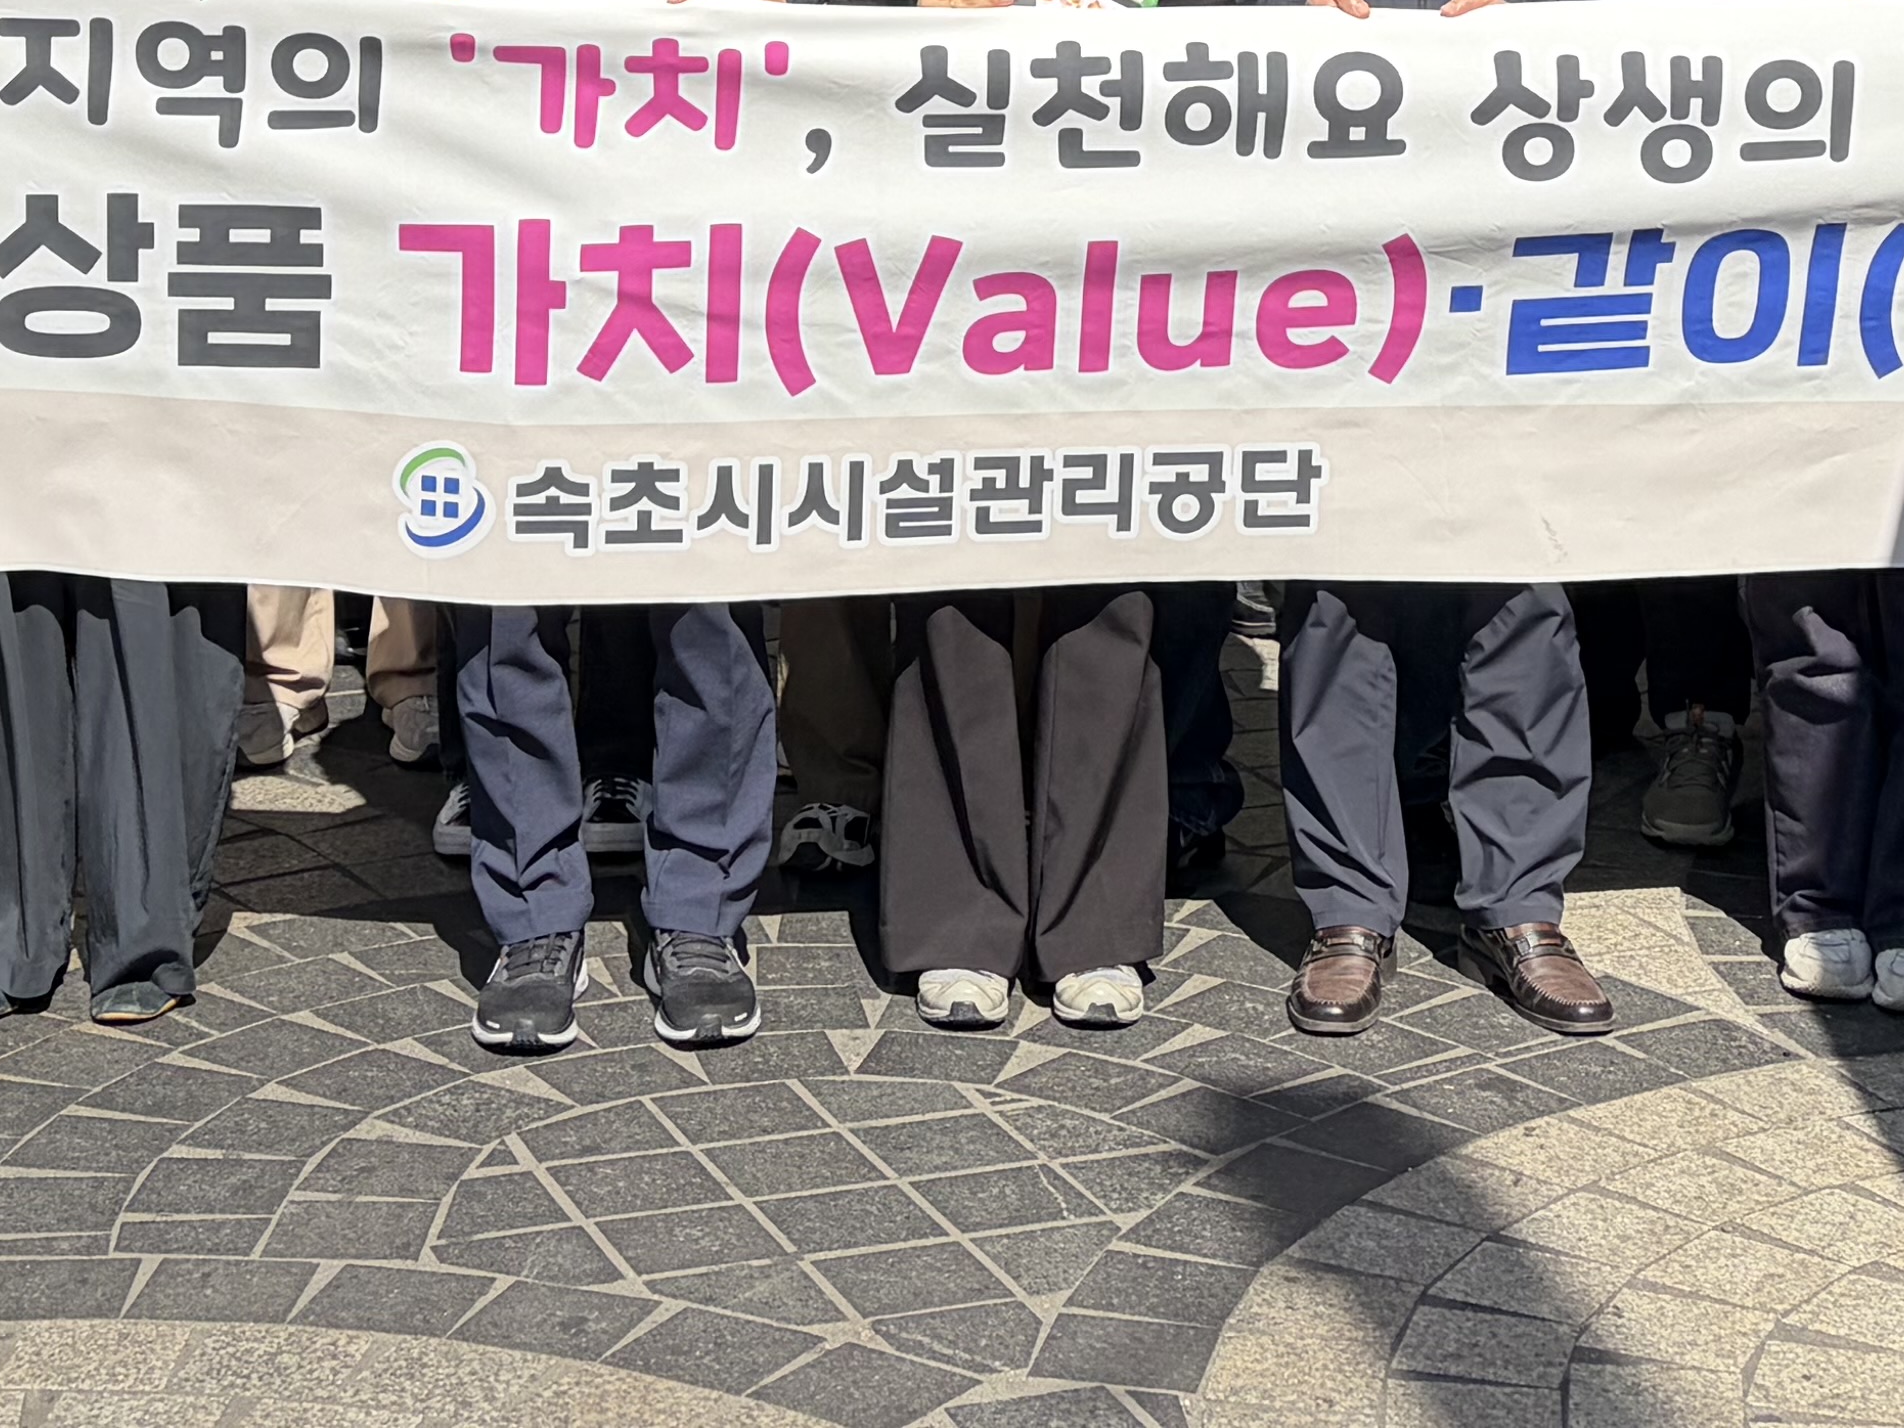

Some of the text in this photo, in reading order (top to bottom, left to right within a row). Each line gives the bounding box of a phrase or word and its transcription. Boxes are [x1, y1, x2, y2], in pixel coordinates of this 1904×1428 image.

[450, 31, 833, 173] '가치',
[895, 40, 1408, 170] 실천해요
[1469, 48, 1857, 183] 상생의
[509, 447, 1323, 552] 속초시시설관리공단
